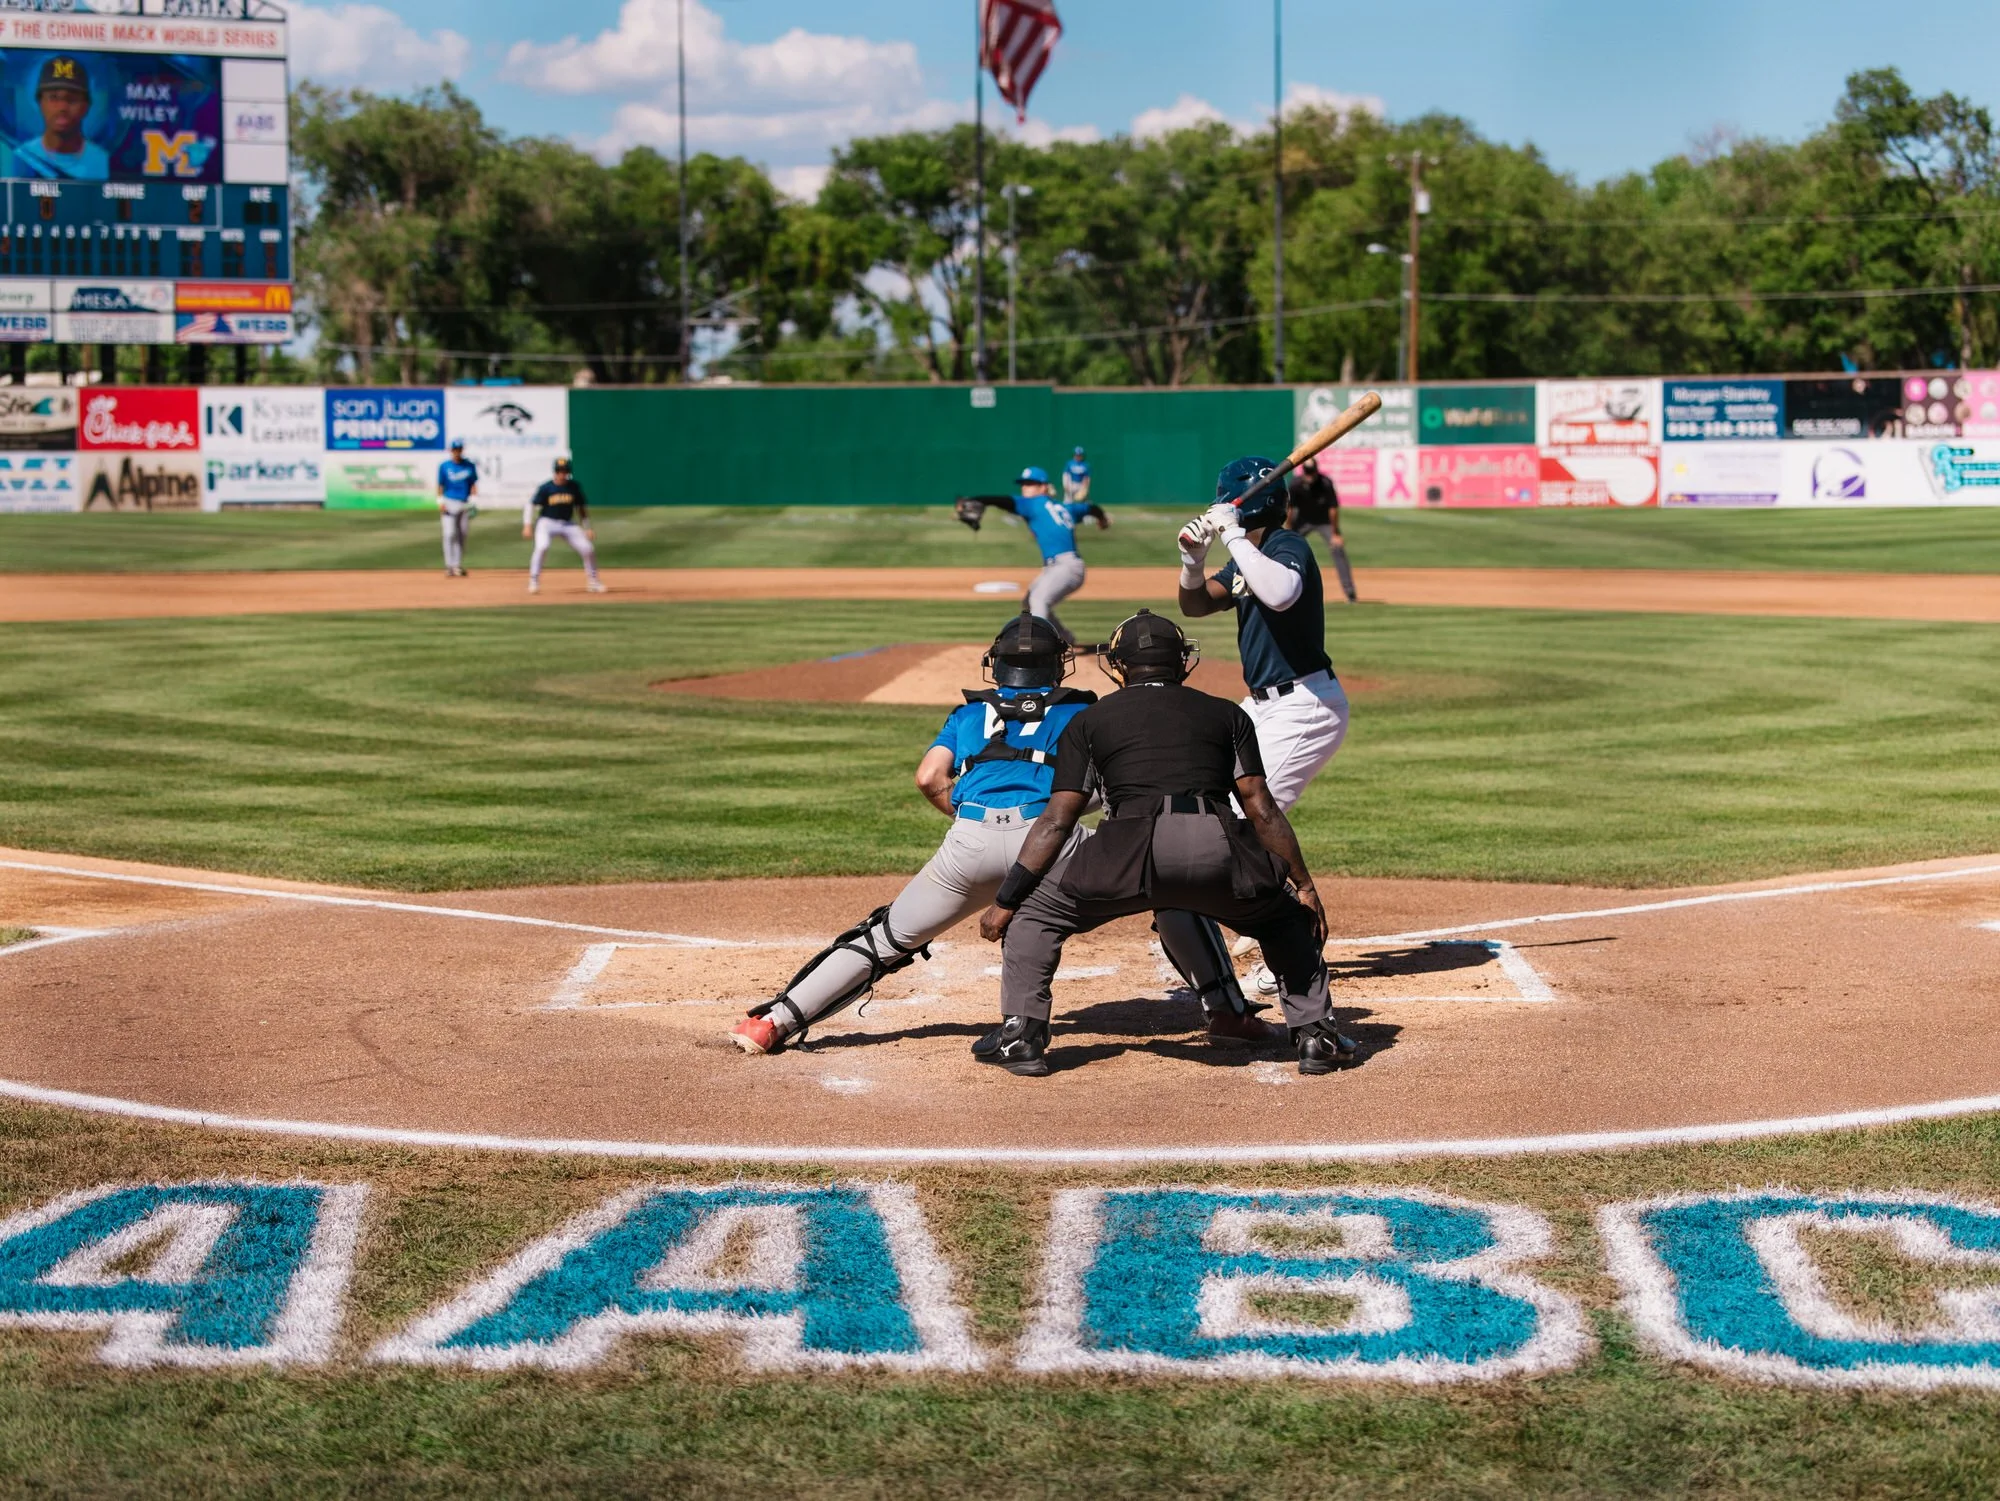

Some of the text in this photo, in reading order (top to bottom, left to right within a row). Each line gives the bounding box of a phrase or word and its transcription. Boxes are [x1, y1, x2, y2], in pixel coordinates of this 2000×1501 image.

[13, 21, 41, 39] THE
[47, 22, 105, 41] CONNIE
[112, 25, 157, 43] MACK
[162, 28, 218, 46] WORLD
[223, 31, 278, 48] SERIES
[126, 83, 171, 101] MAX
[119, 106, 179, 122] WILEY
[30, 182, 61, 197] BALL
[102, 183, 146, 200] STRIKE
[1673, 385, 1770, 403] Morgan Stanley
[332, 397, 440, 421] san juan
[252, 426, 319, 443] Leavitt
[332, 419, 440, 440] PRINTING
[118, 457, 198, 508] Alpine
[207, 459, 319, 491] Parker's
